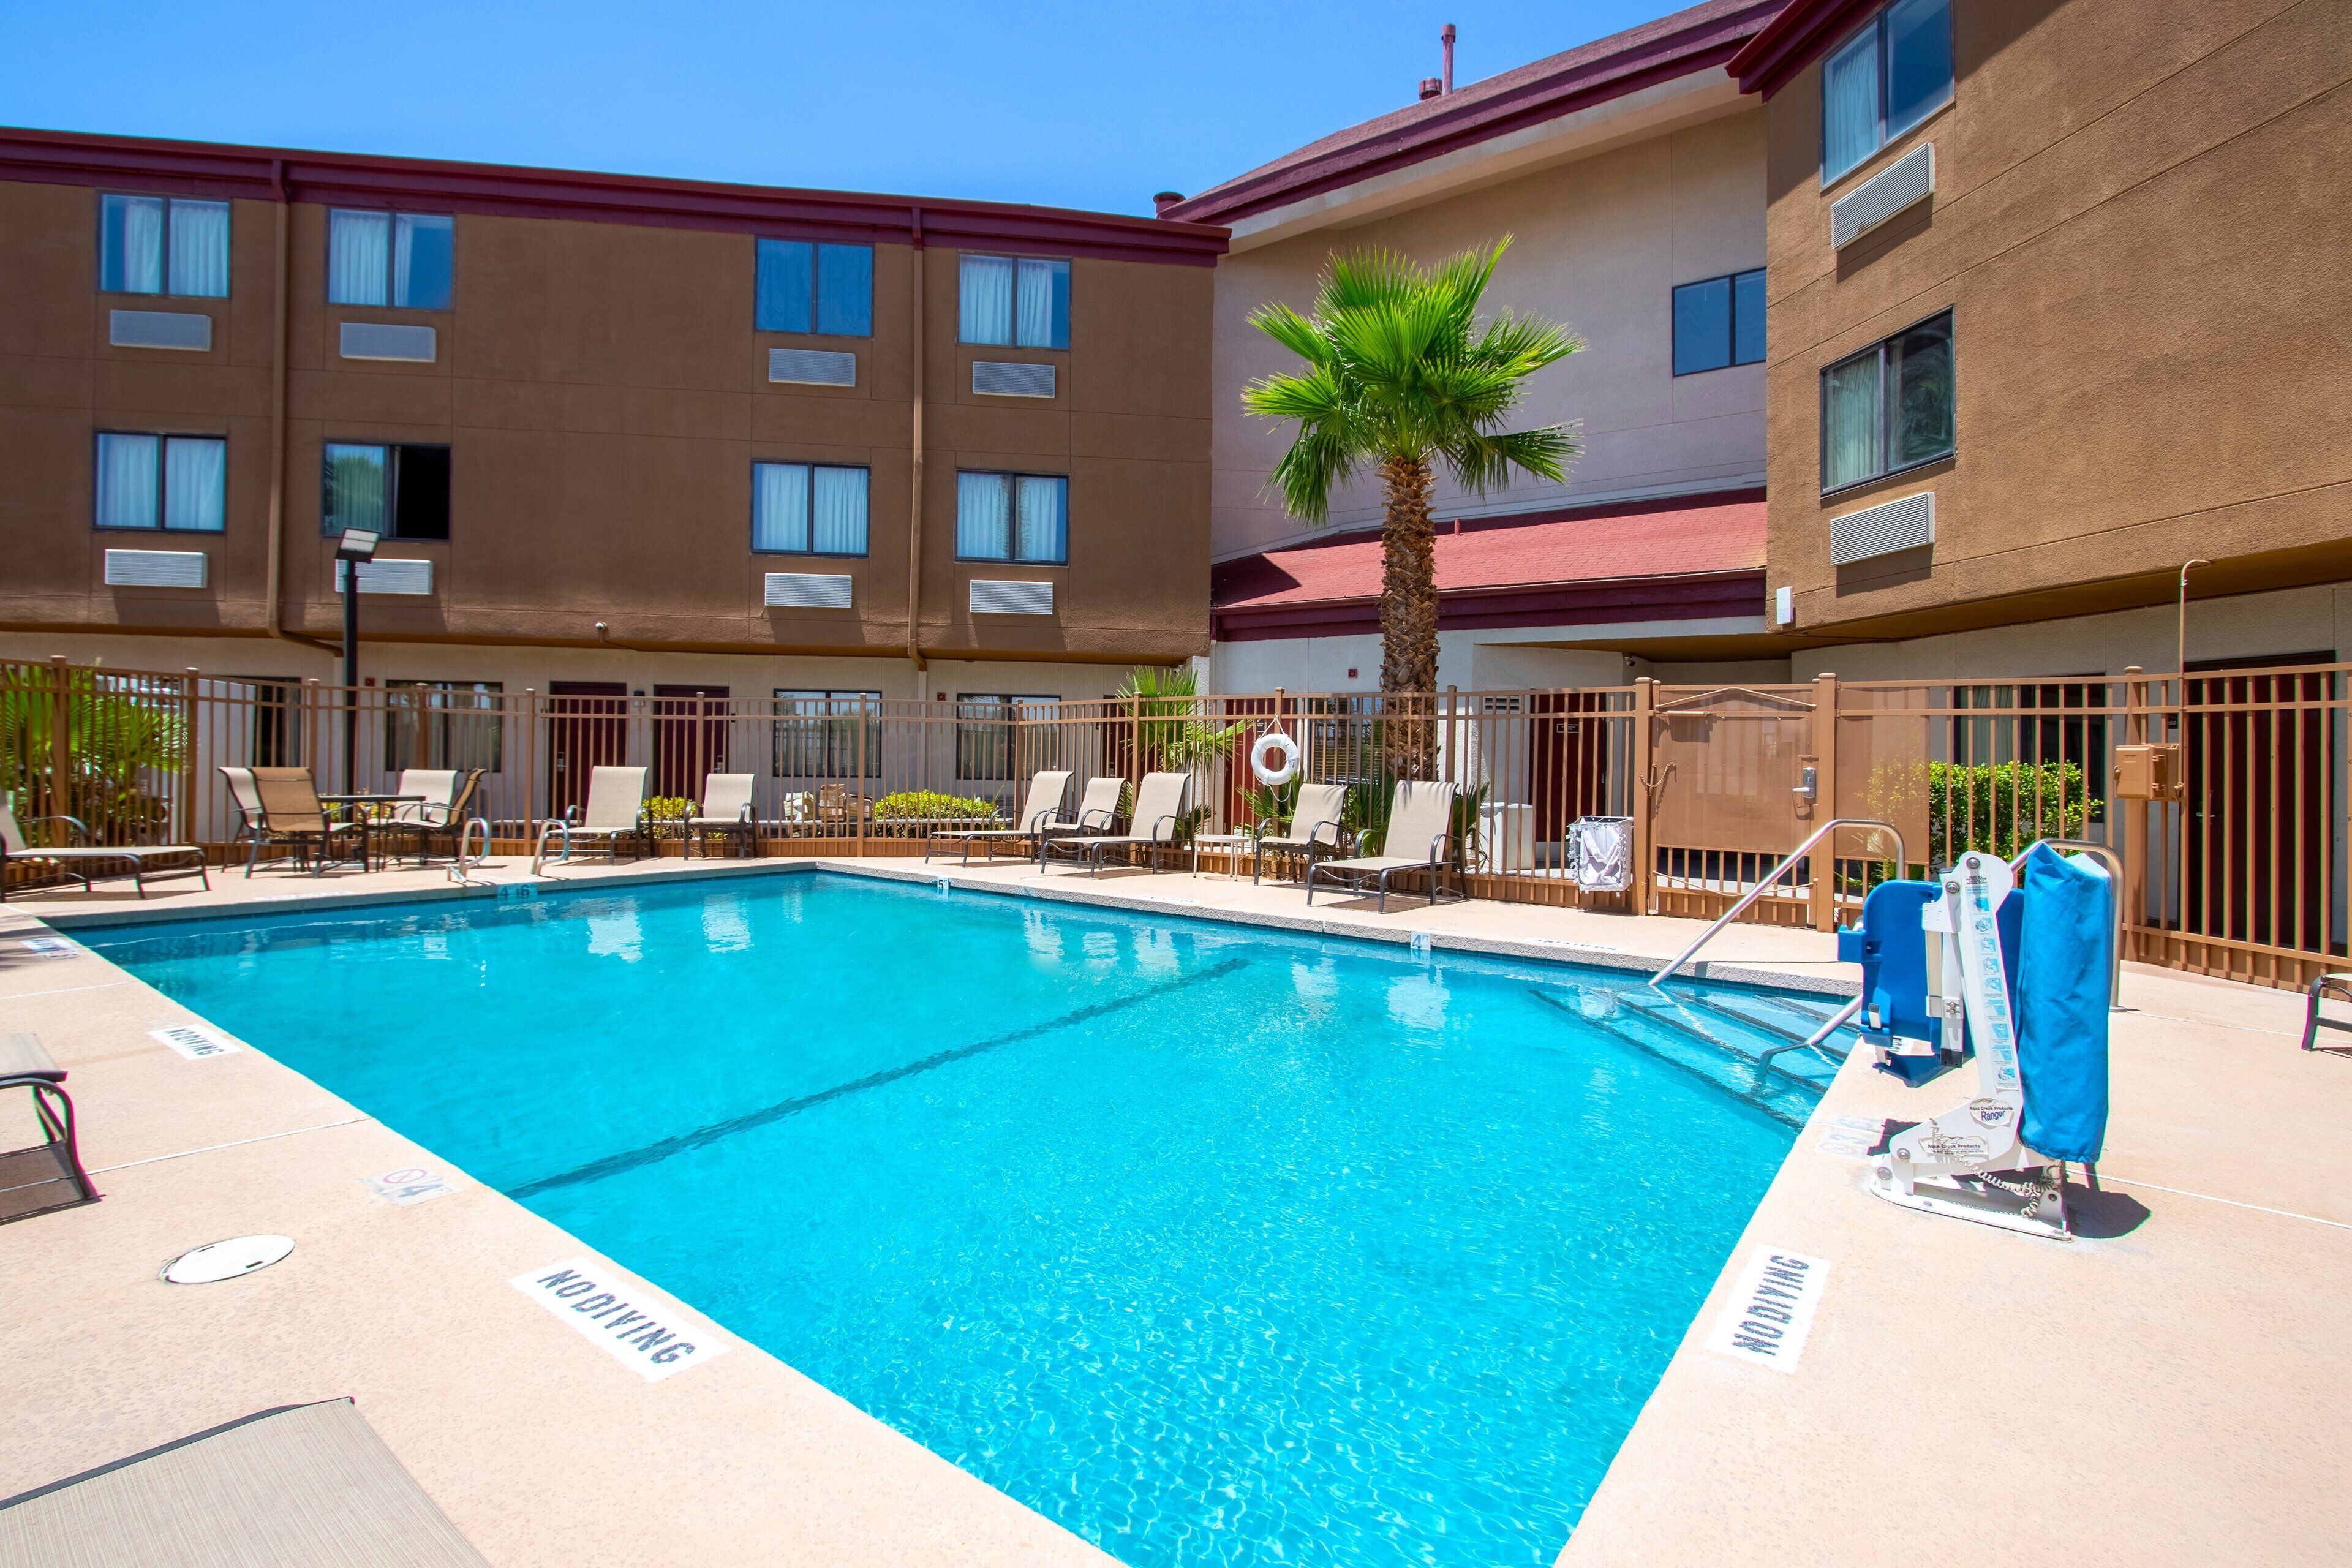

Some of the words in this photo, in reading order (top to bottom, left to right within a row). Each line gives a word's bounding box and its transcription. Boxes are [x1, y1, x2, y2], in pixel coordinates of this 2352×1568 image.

[938, 879, 944, 888] 5
[499, 886, 509, 896] 4
[521, 884, 530, 896] 6
[1412, 934, 1422, 949] 4
[1981, 1110, 2005, 1121] Ranger
